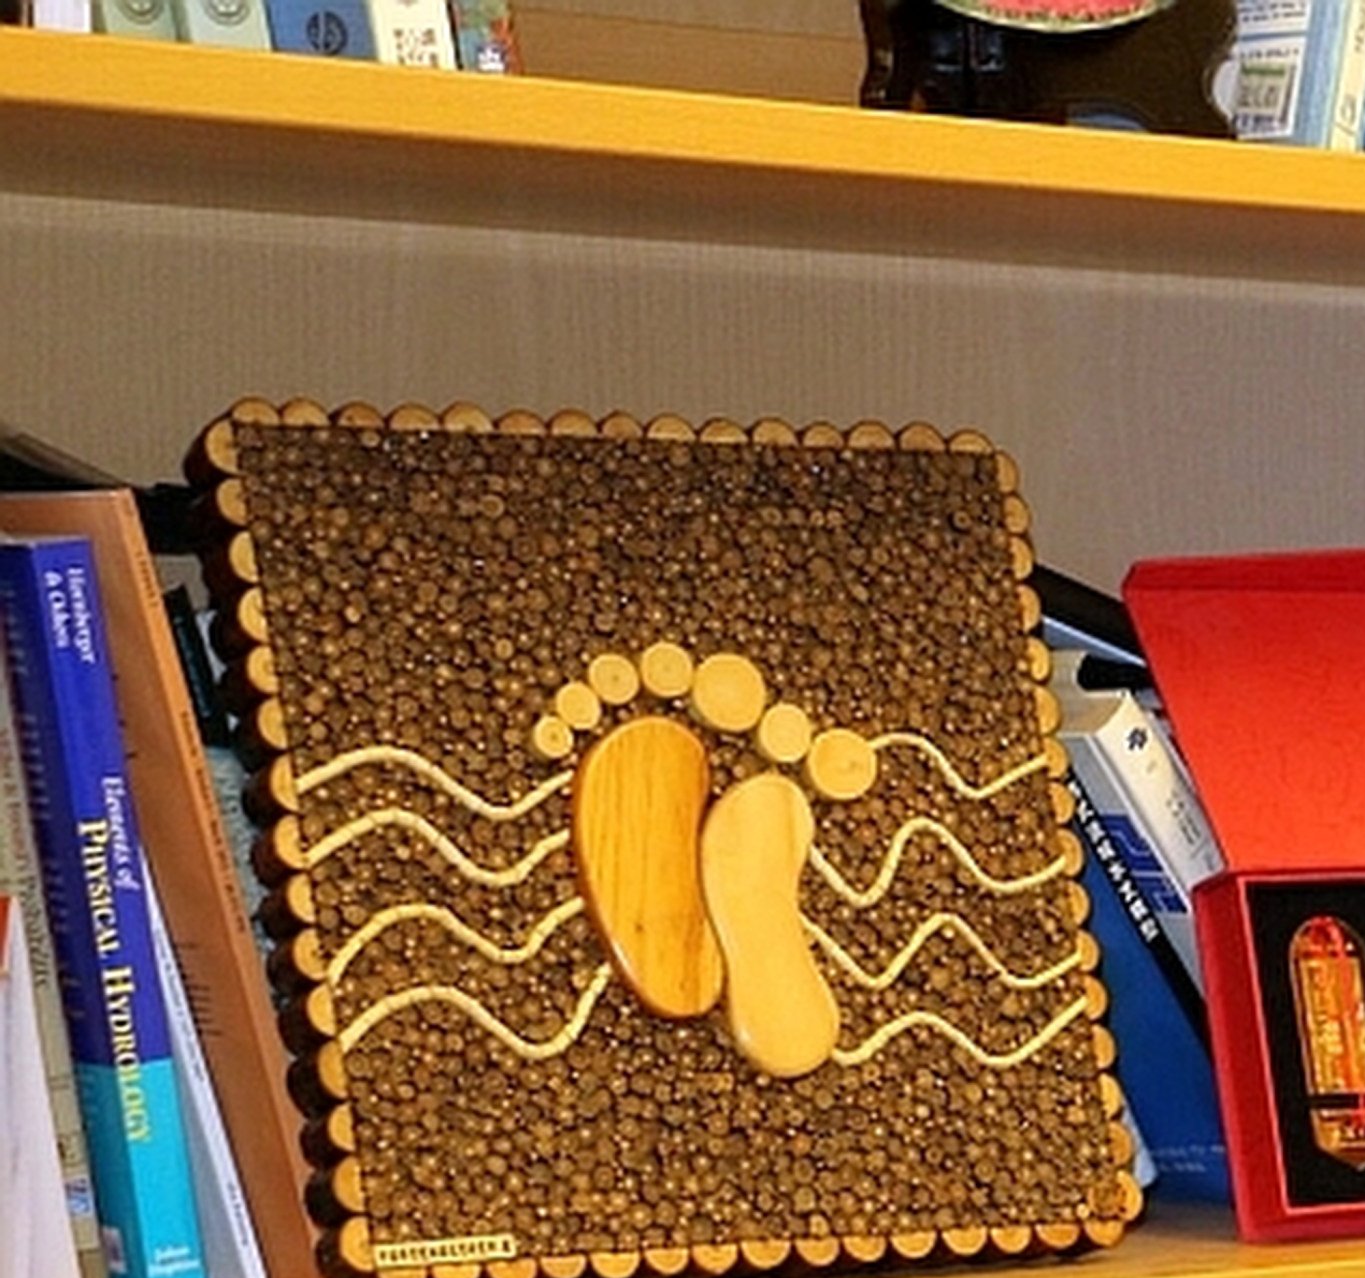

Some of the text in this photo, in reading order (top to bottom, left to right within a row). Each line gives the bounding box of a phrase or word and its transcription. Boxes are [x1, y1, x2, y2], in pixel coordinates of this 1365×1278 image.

[64, 566, 99, 665] Hornberger
[101, 775, 139, 893] Elements of
[78, 819, 152, 1144] PHYSICAL HYDROLOGY
